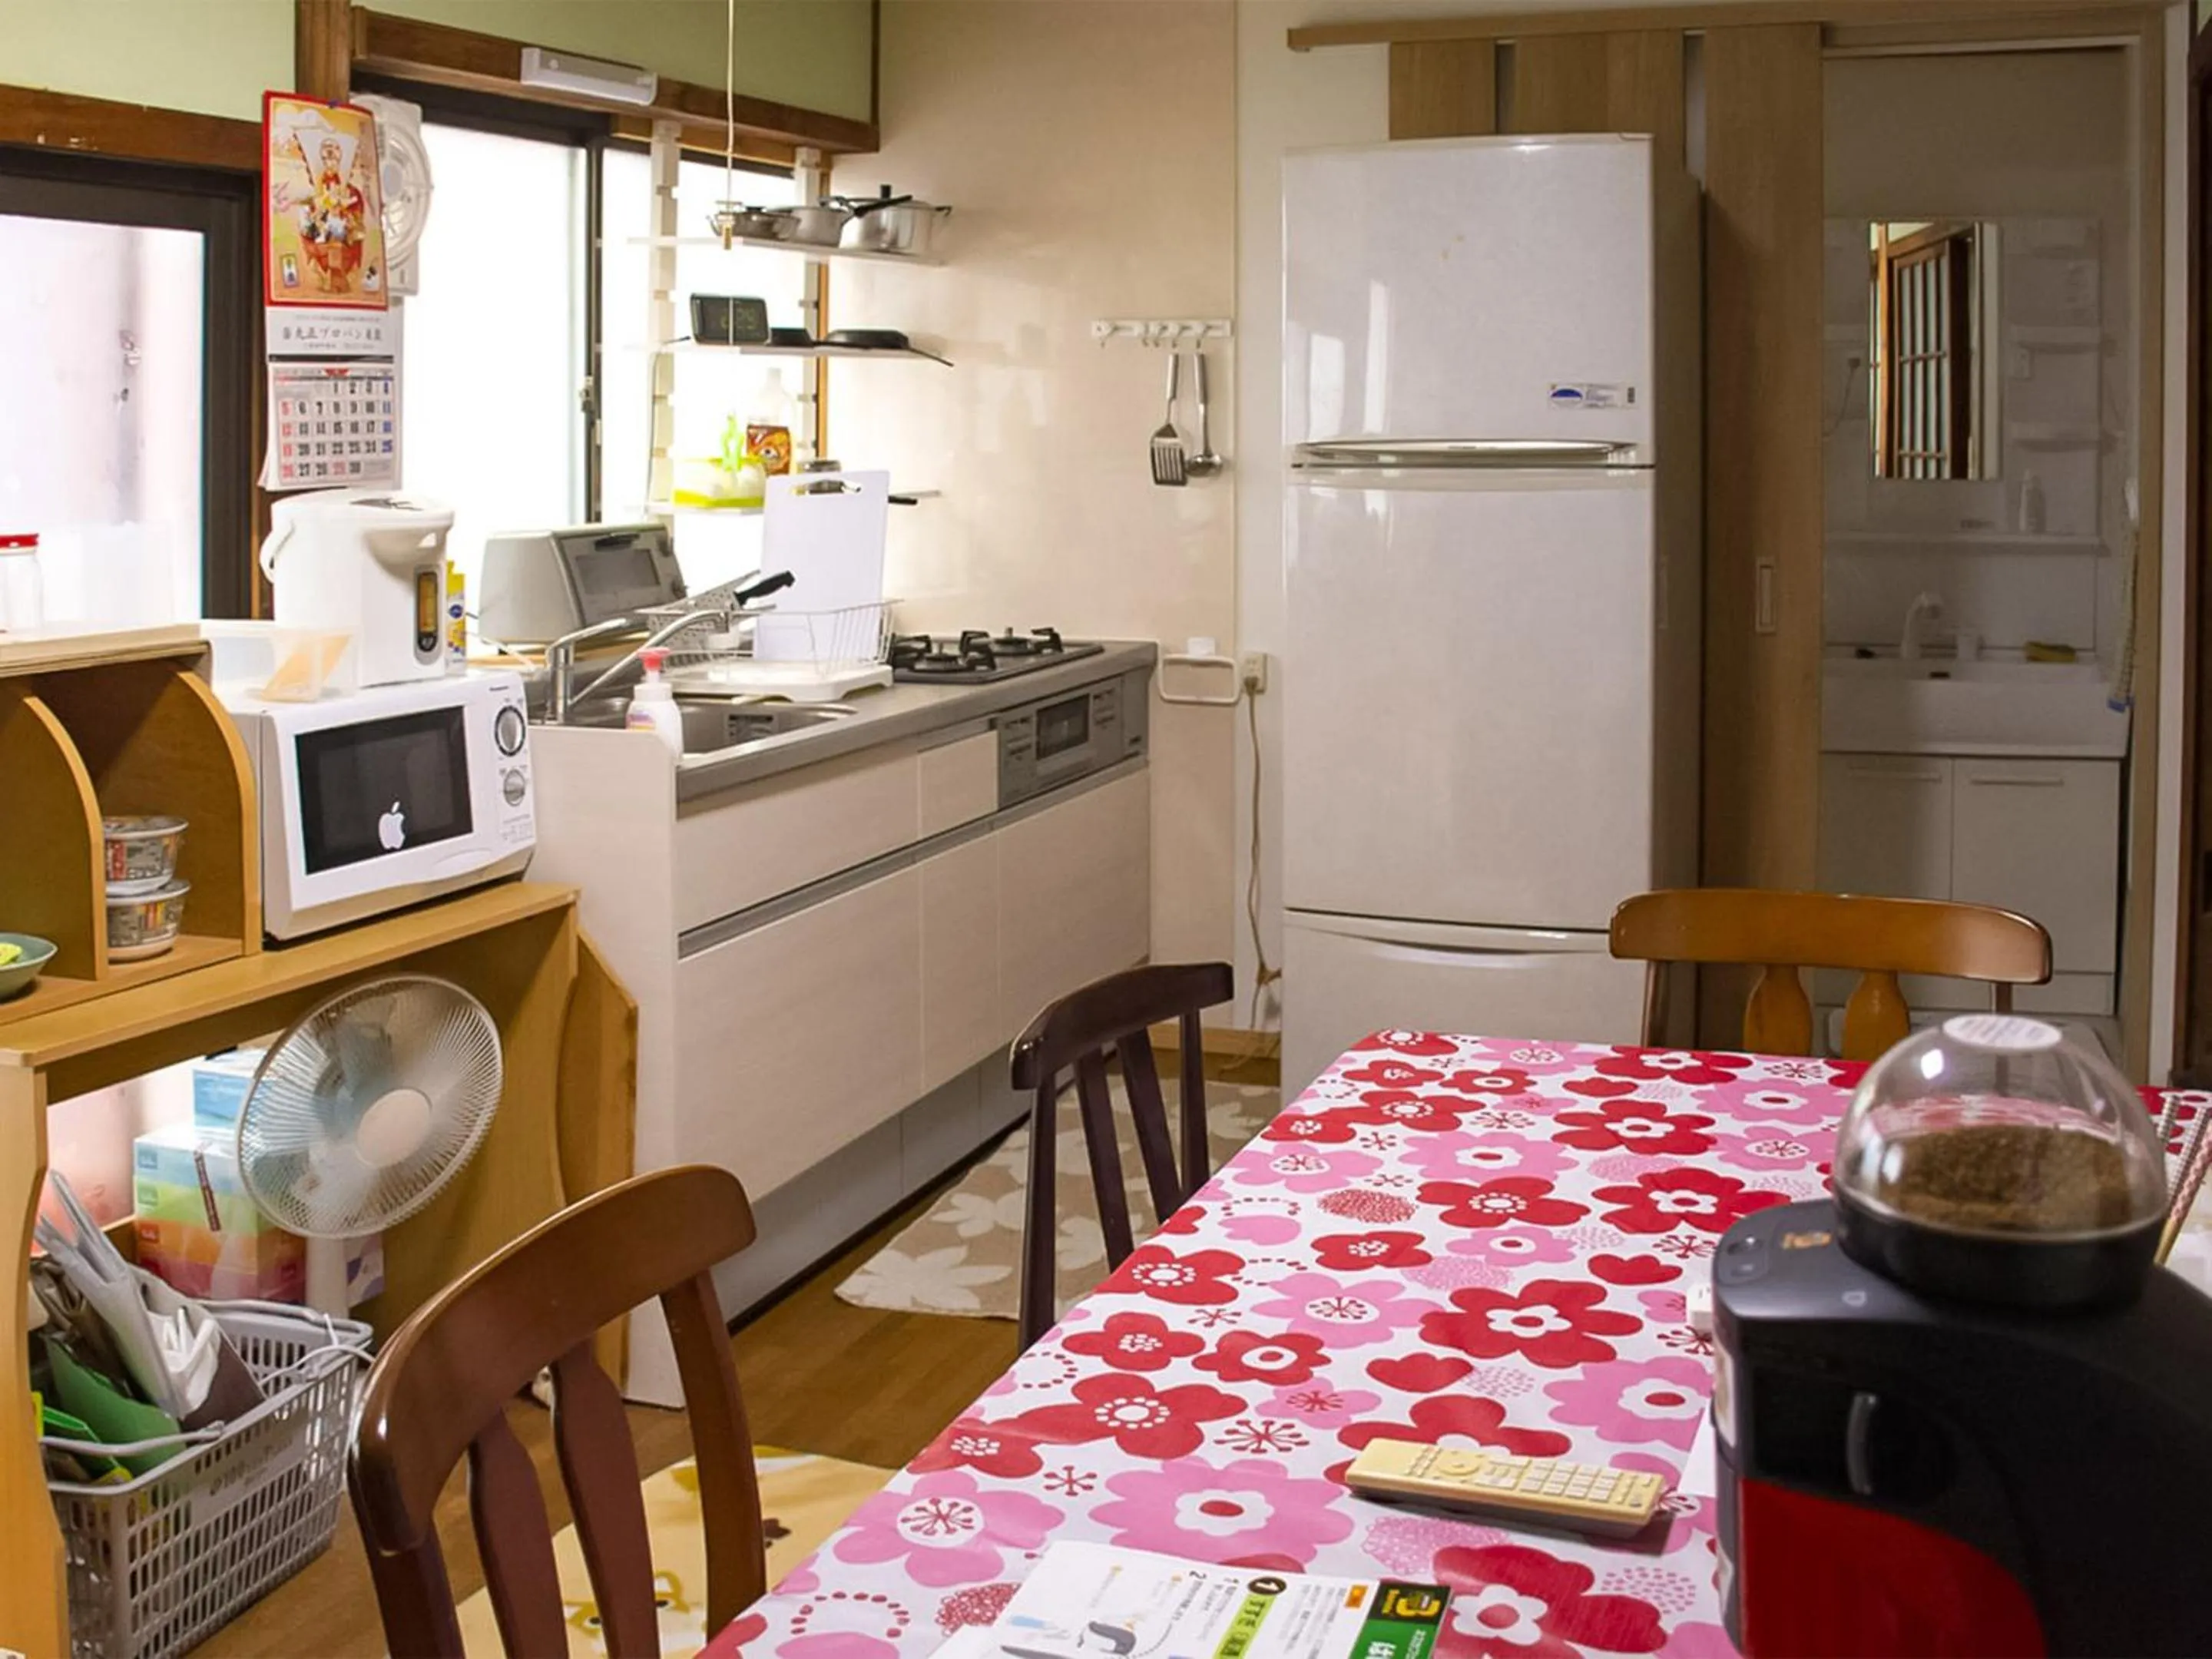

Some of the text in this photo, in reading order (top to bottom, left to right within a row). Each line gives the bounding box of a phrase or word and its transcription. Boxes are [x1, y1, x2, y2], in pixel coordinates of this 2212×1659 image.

[349, 380, 356, 395] 2
[299, 401, 306, 415] 6
[316, 401, 323, 416] 7
[1255, 1581, 1280, 1591] 1
